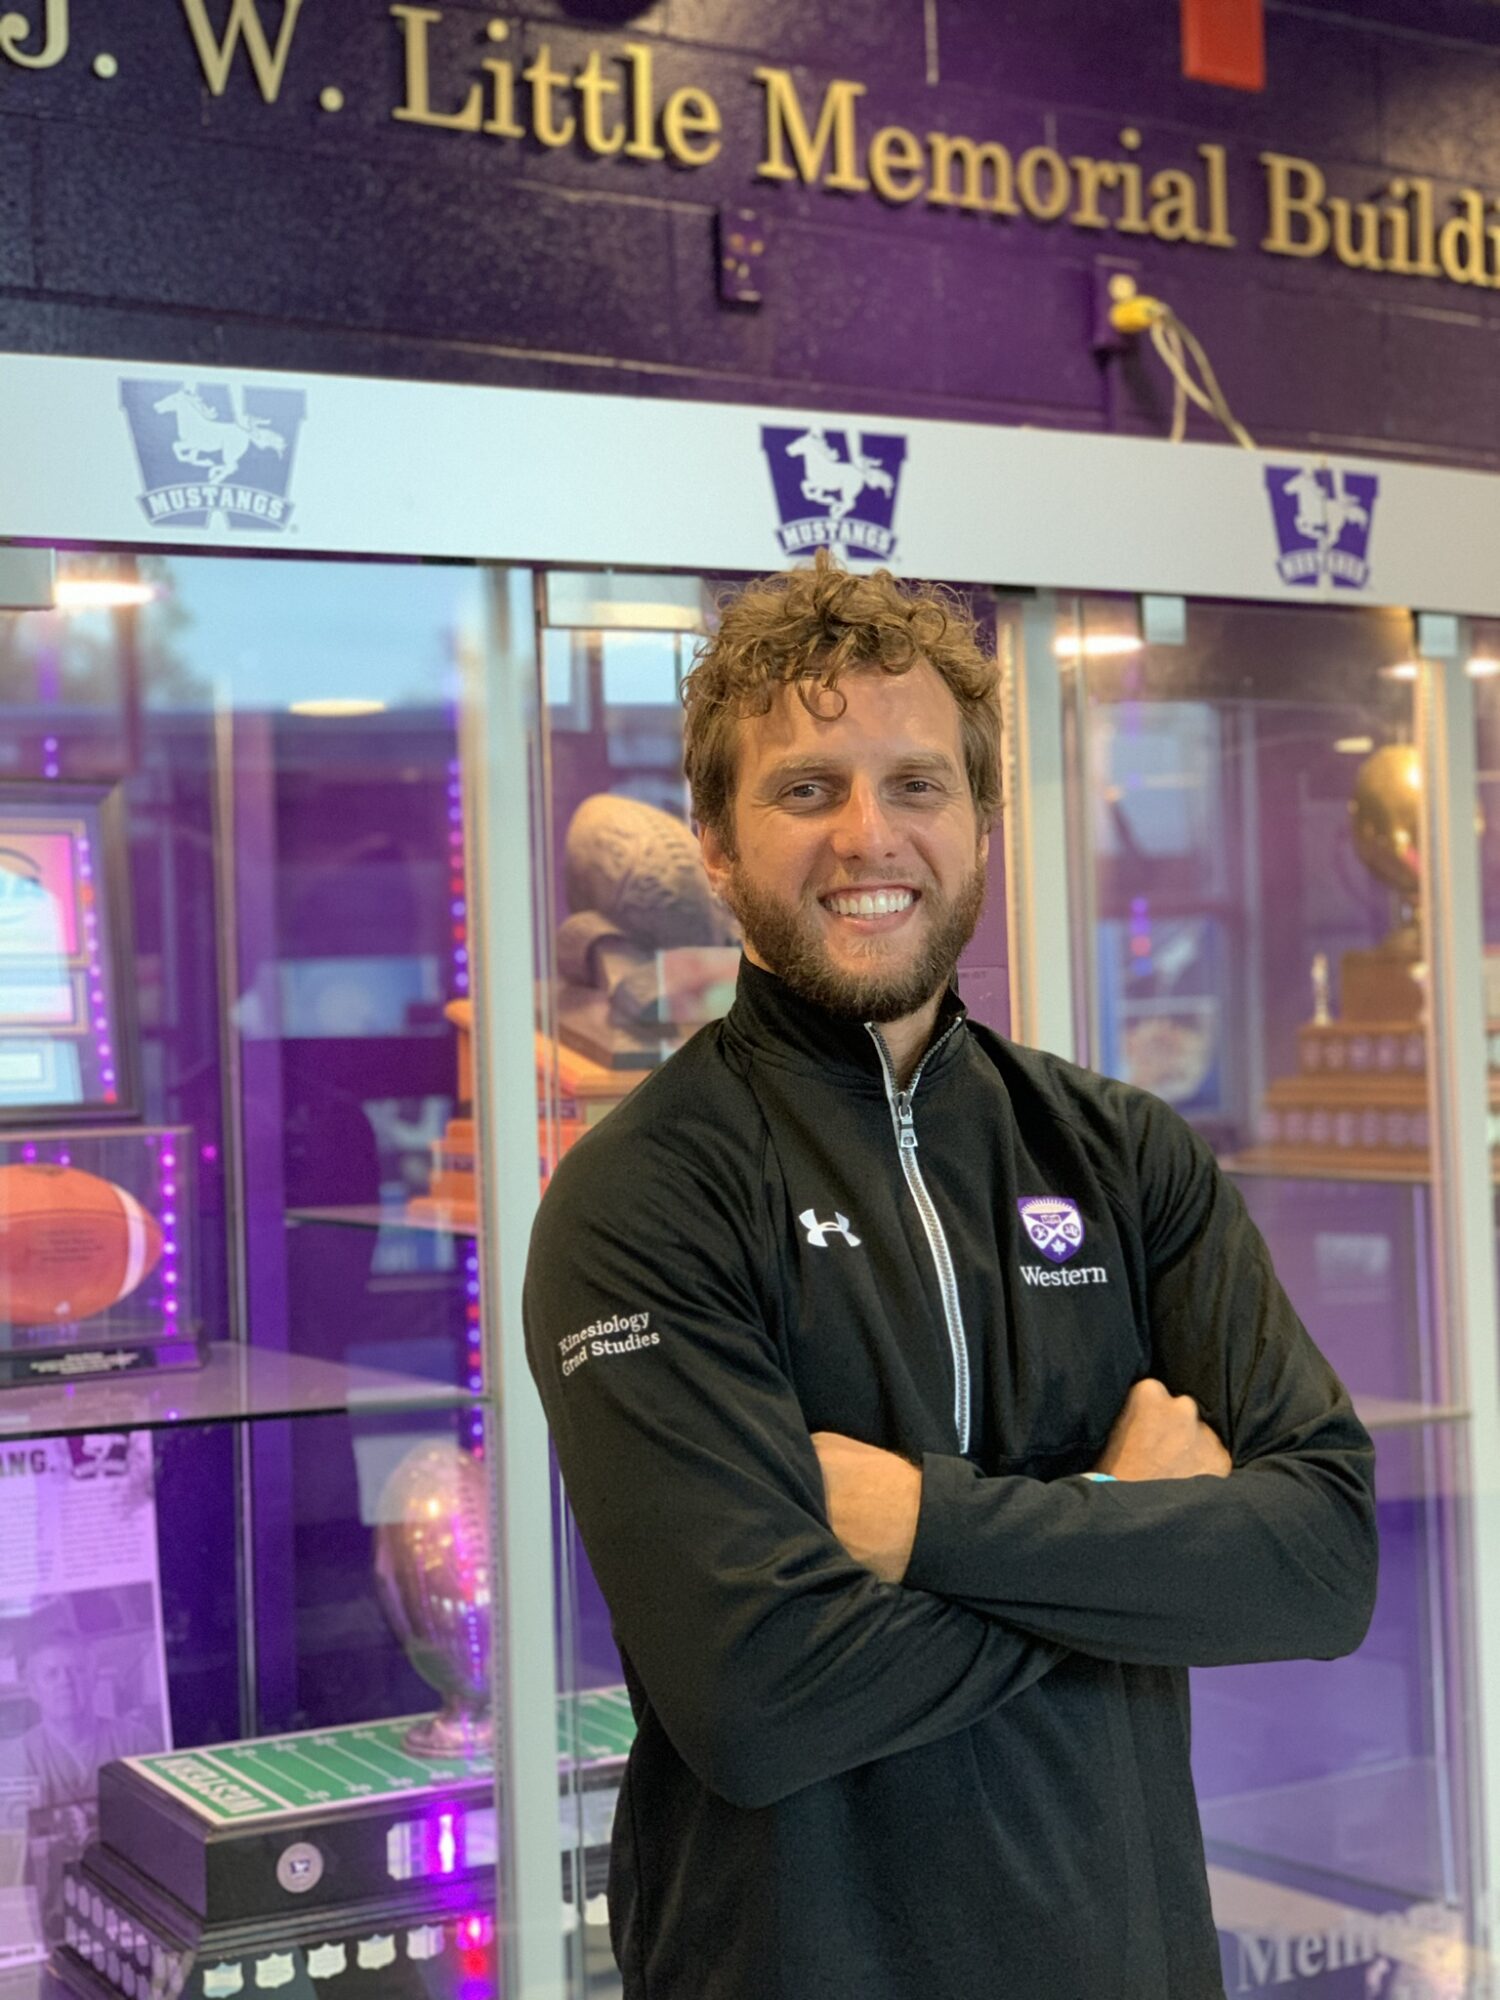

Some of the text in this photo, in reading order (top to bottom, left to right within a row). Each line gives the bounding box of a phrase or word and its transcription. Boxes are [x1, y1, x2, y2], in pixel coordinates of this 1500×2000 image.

[184, 0, 344, 112] W.
[390, 5, 723, 166] Little
[753, 66, 1236, 248] Memorial
[147, 486, 285, 520] MUSTANGS
[1019, 1265, 1108, 1287] Western
[558, 1312, 650, 1356] Kinesiology
[562, 1332, 660, 1376] Grad Studies
